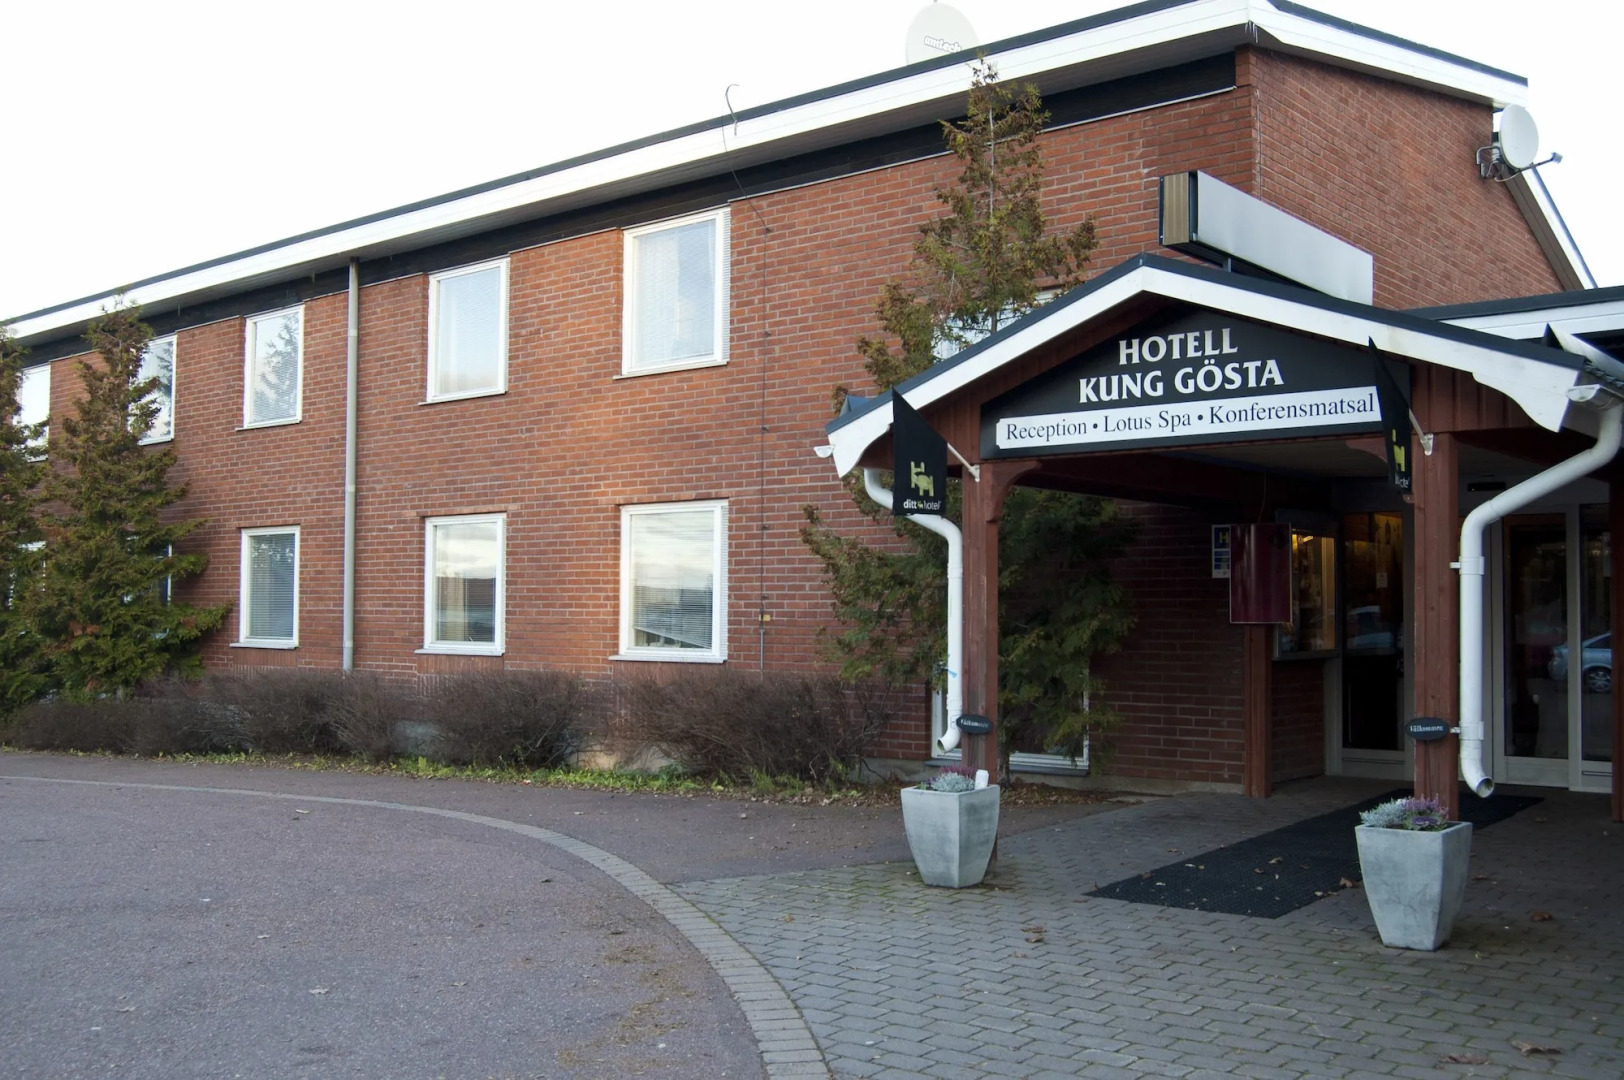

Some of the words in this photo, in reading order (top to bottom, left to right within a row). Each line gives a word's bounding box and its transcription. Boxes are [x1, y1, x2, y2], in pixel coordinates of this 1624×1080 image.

[1118, 327, 1239, 366] HOTELL
[1079, 370, 1164, 404] KUNG
[1174, 358, 1285, 395] GÖSTA
[1006, 418, 1088, 442] Reception
[1103, 415, 1153, 433] Lotus
[1158, 410, 1192, 433] Spa
[1208, 392, 1376, 425] Konferensmatsal
[903, 499, 918, 510] ditt
[923, 499, 941, 511] hotel
